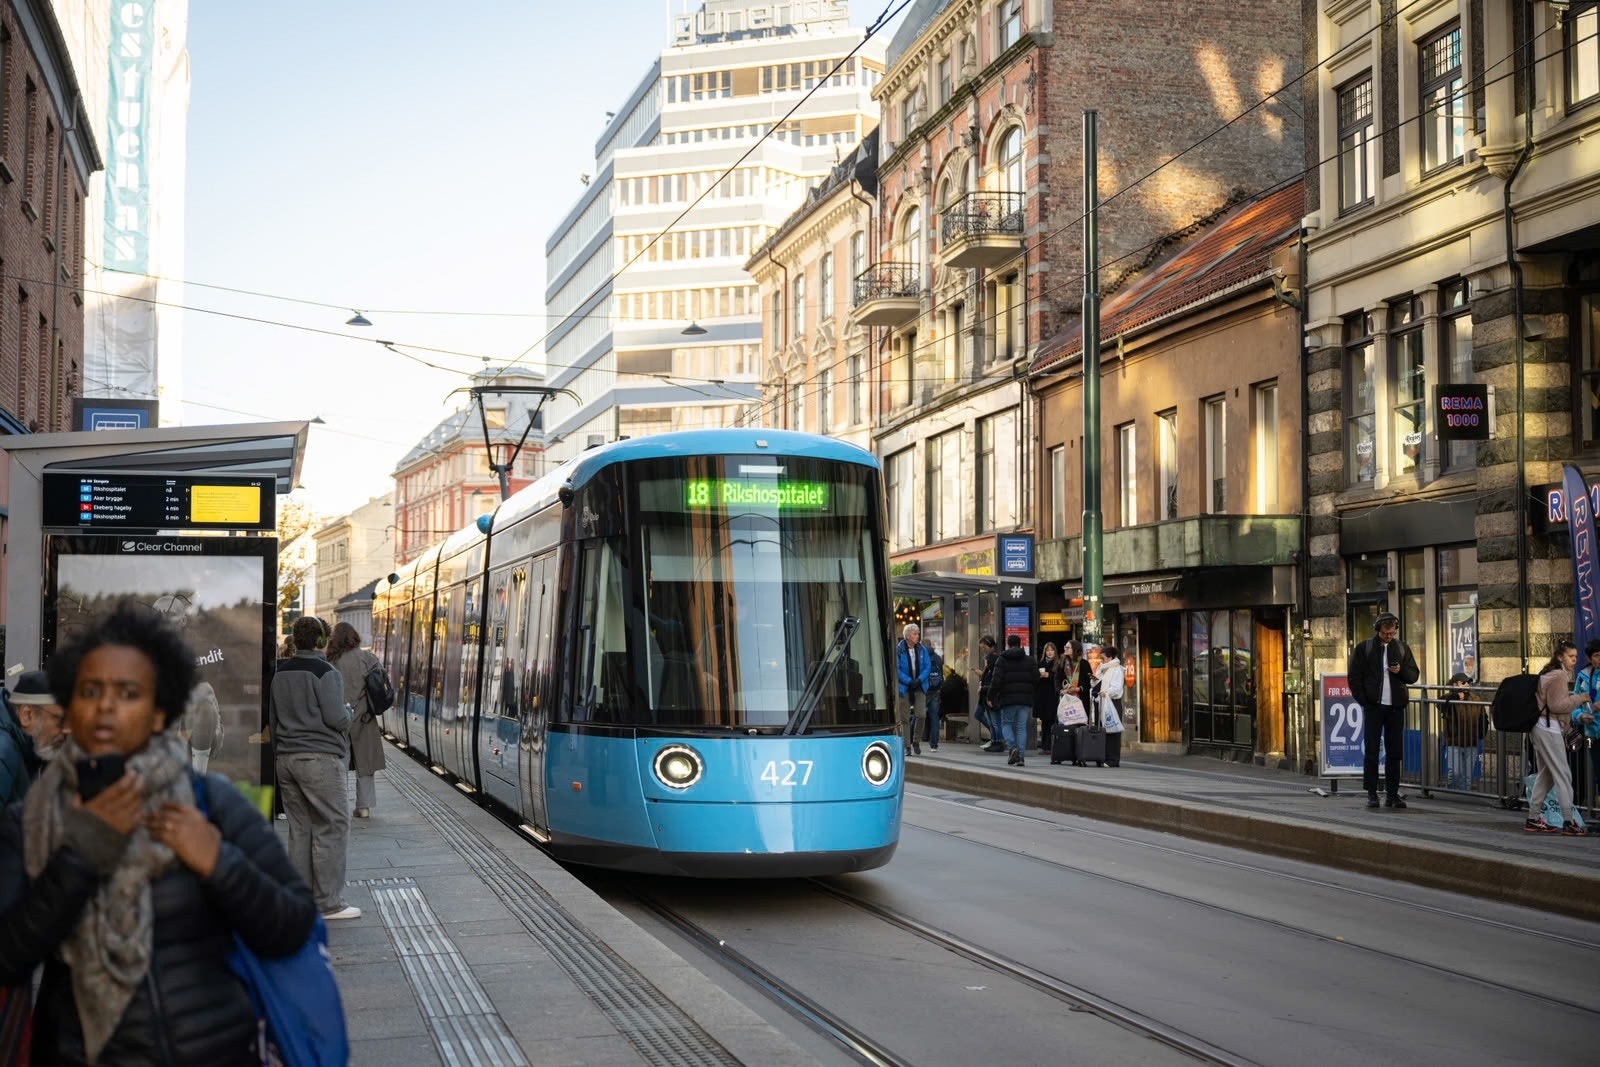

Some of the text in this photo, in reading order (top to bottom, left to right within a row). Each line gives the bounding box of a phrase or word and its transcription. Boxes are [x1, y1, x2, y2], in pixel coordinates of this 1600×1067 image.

[1441, 396, 1483, 410] REMA
[1446, 414, 1480, 427] 1000
[688, 482, 824, 507] 18 Rikshospitalet
[113, 504, 132, 512] hageby
[136, 542, 202, 551] Clear Channel
[1573, 495, 1594, 630] REMA
[1452, 627, 1465, 660] 14
[1328, 687, 1340, 696] FØR
[1329, 702, 1364, 744] 29
[760, 760, 814, 786] 427
